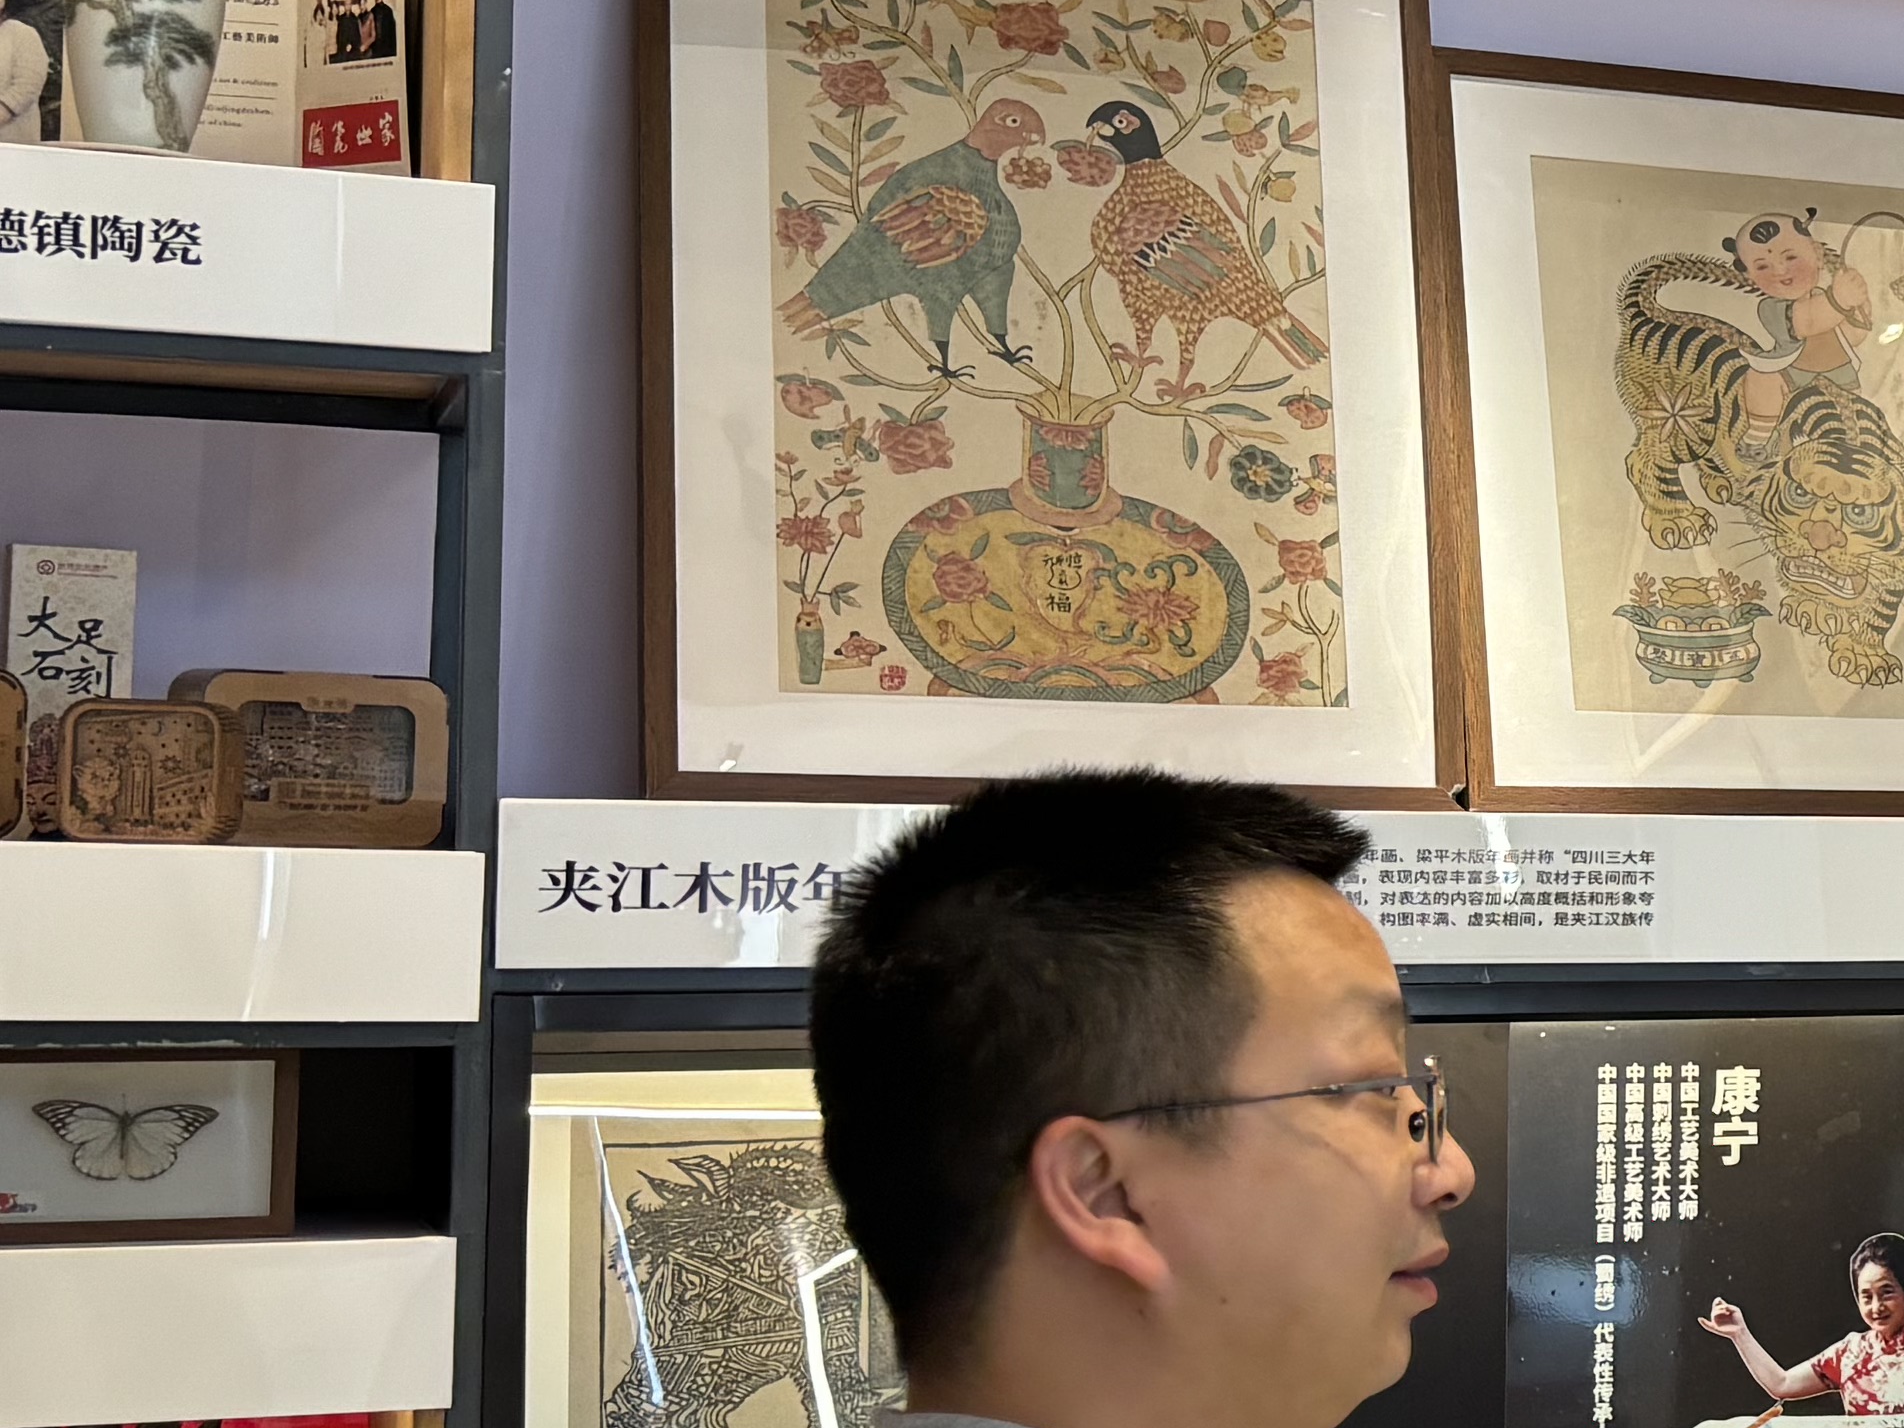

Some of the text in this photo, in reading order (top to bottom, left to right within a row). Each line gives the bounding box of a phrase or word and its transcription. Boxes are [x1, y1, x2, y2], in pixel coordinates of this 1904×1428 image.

[17, 596, 119, 655] 大足
[20, 650, 114, 700] 石刻
[1622, 1062, 1645, 1243] 中国高级工艺美术师
[1651, 1062, 1673, 1222] 中国刺绣艺术大师
[1678, 1061, 1700, 1221] 中国工艺美术大师
[1712, 1065, 1762, 1166] 康宁
